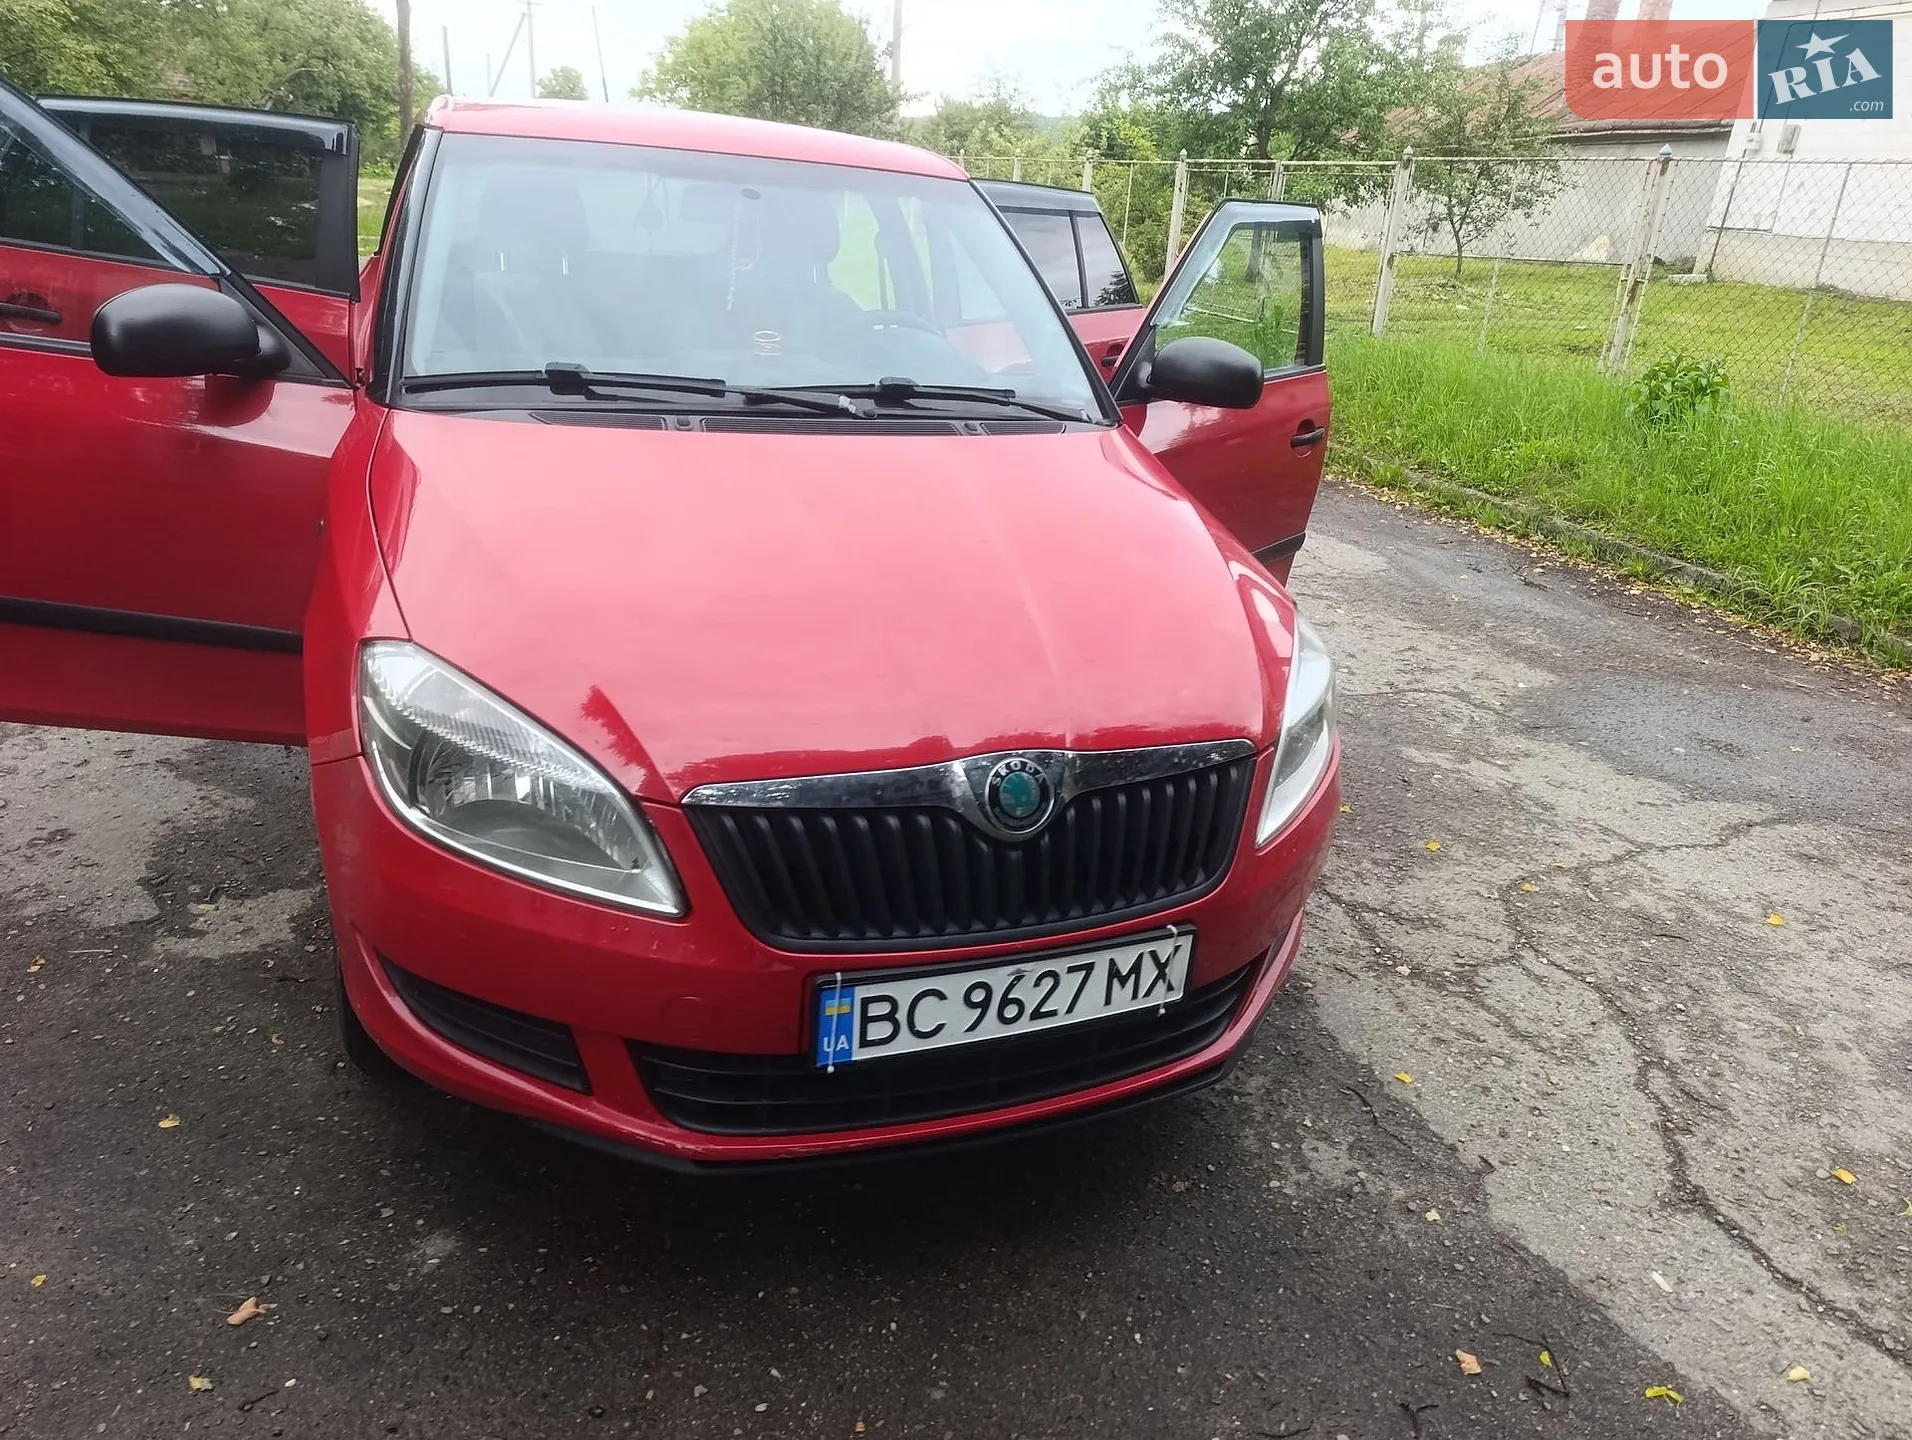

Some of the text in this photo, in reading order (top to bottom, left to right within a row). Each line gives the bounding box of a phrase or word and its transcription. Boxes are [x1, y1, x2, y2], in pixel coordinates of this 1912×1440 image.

[858, 943, 1182, 1049] BC 9627 MX
[822, 1034, 850, 1052] UA
